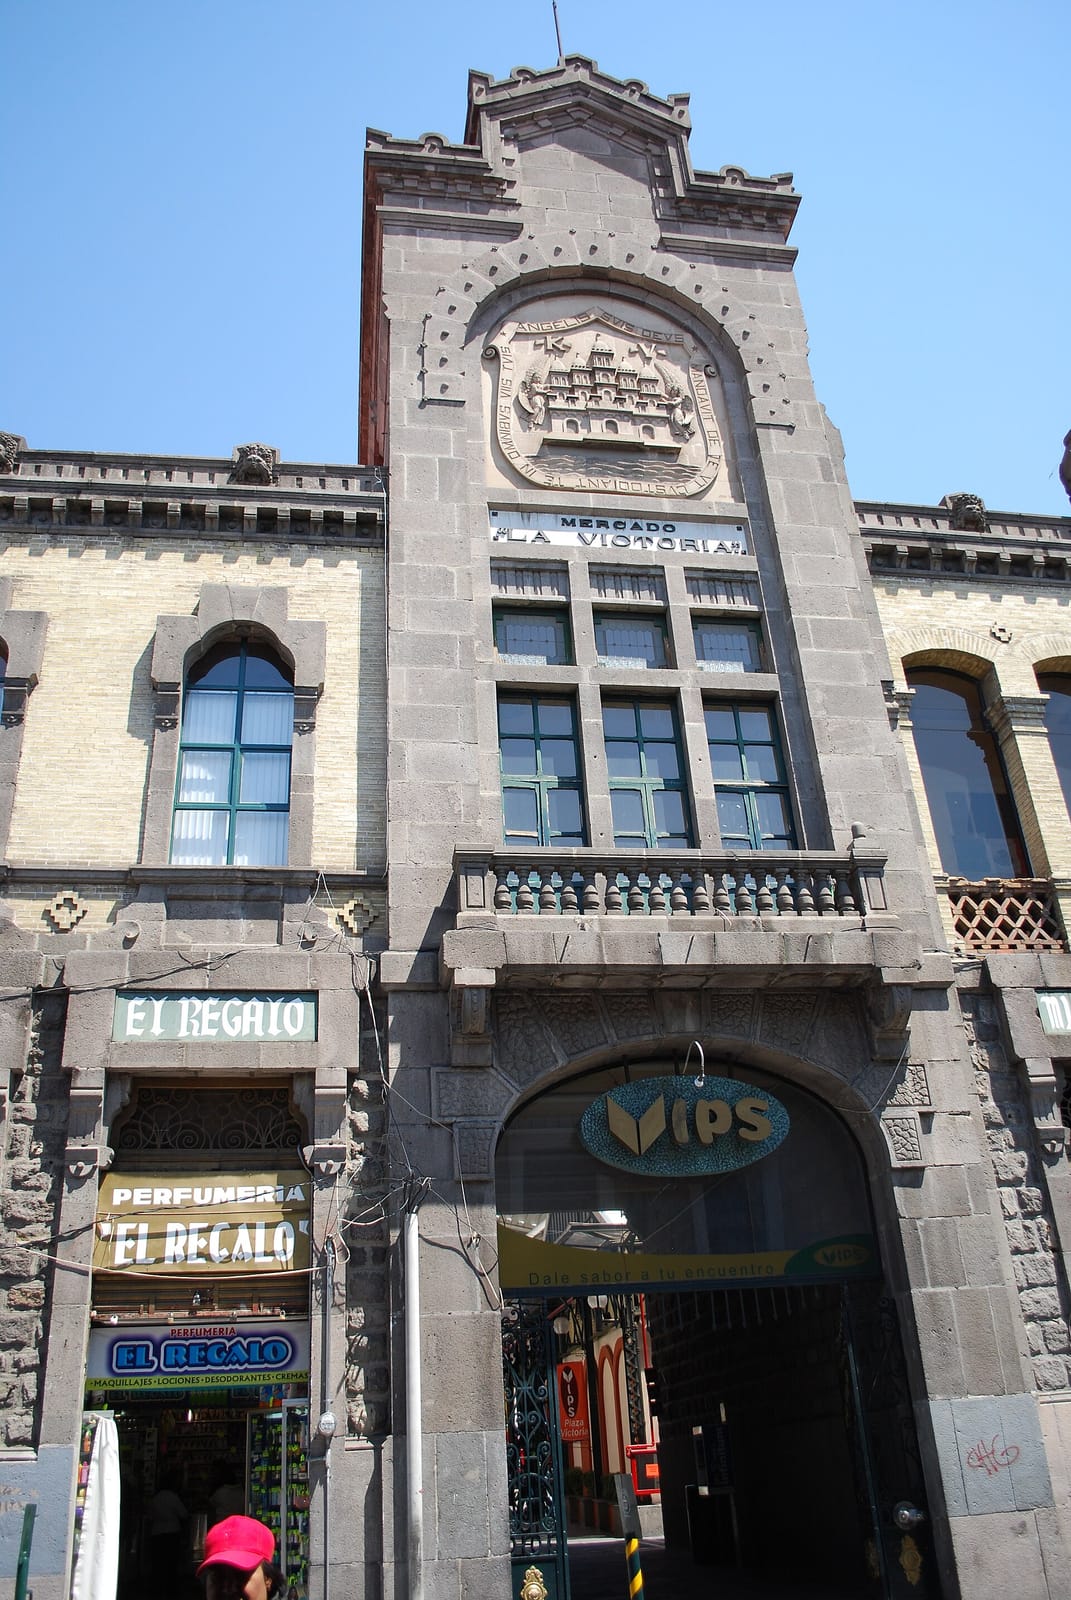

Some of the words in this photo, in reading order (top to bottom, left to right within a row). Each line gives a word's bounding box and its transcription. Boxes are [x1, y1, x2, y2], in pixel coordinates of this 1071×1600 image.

[516, 313, 590, 332] ANGELIS
[600, 311, 636, 333] SVIS
[641, 328, 685, 343] DEVS
[498, 405, 521, 460] OMNIBVS
[519, 463, 537, 478] IN
[560, 517, 677, 533] MERCADO
[111, 1184, 306, 1207] PERFUMERIA
[529, 1271, 570, 1286] Dale
[580, 1268, 632, 1283] sabor
[640, 1271, 650, 1281] a
[658, 1266, 676, 1279] tu
[685, 1263, 775, 1278] encuentro
[170, 1326, 237, 1338] PERFUMERIA
[115, 1344, 154, 1369] EL
[164, 1340, 289, 1368] REGALO
[94, 1378, 153, 1388] MAQUILLAJES
[157, 1376, 200, 1386] LOCIONES
[205, 1373, 272, 1384] DESODORANTES
[275, 1372, 309, 1380] CREMAS
[564, 1418, 585, 1428] Plaza
[560, 1427, 589, 1438] Victoria
